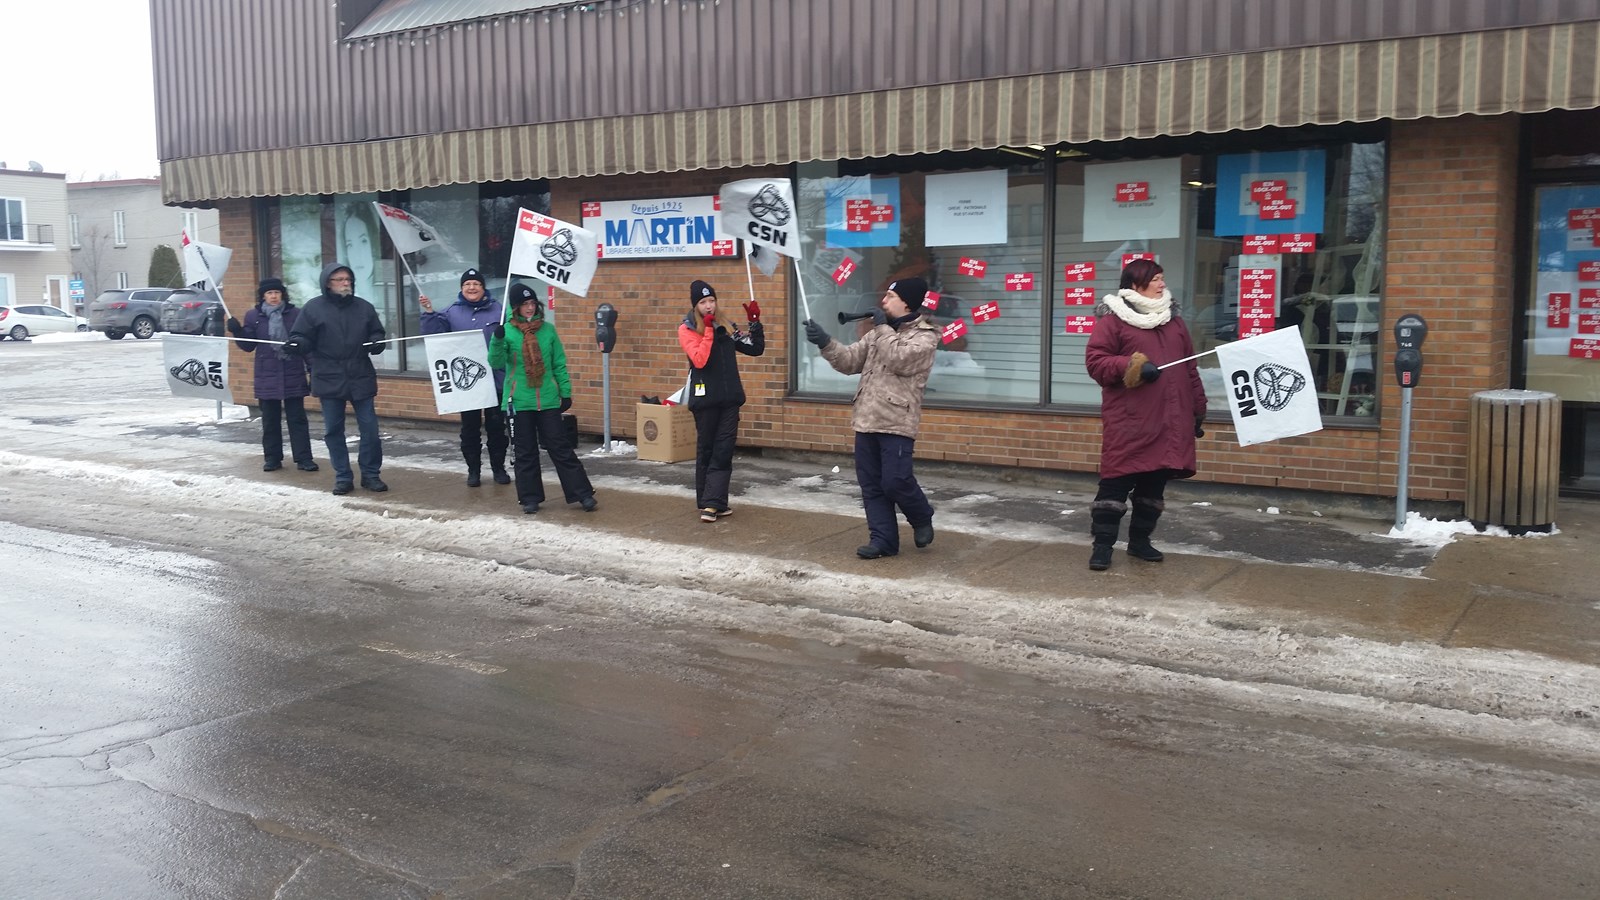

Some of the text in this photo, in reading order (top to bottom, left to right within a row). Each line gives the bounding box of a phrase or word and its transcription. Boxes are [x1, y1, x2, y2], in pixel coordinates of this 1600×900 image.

[631, 201, 683, 213] Depuis 1925
[522, 216, 552, 229] LOCK-OUT
[748, 221, 787, 247] CSN
[536, 260, 571, 284] CSN
[208, 361, 224, 389] CSN
[435, 359, 452, 393] CSN
[1231, 370, 1258, 418] CSN
